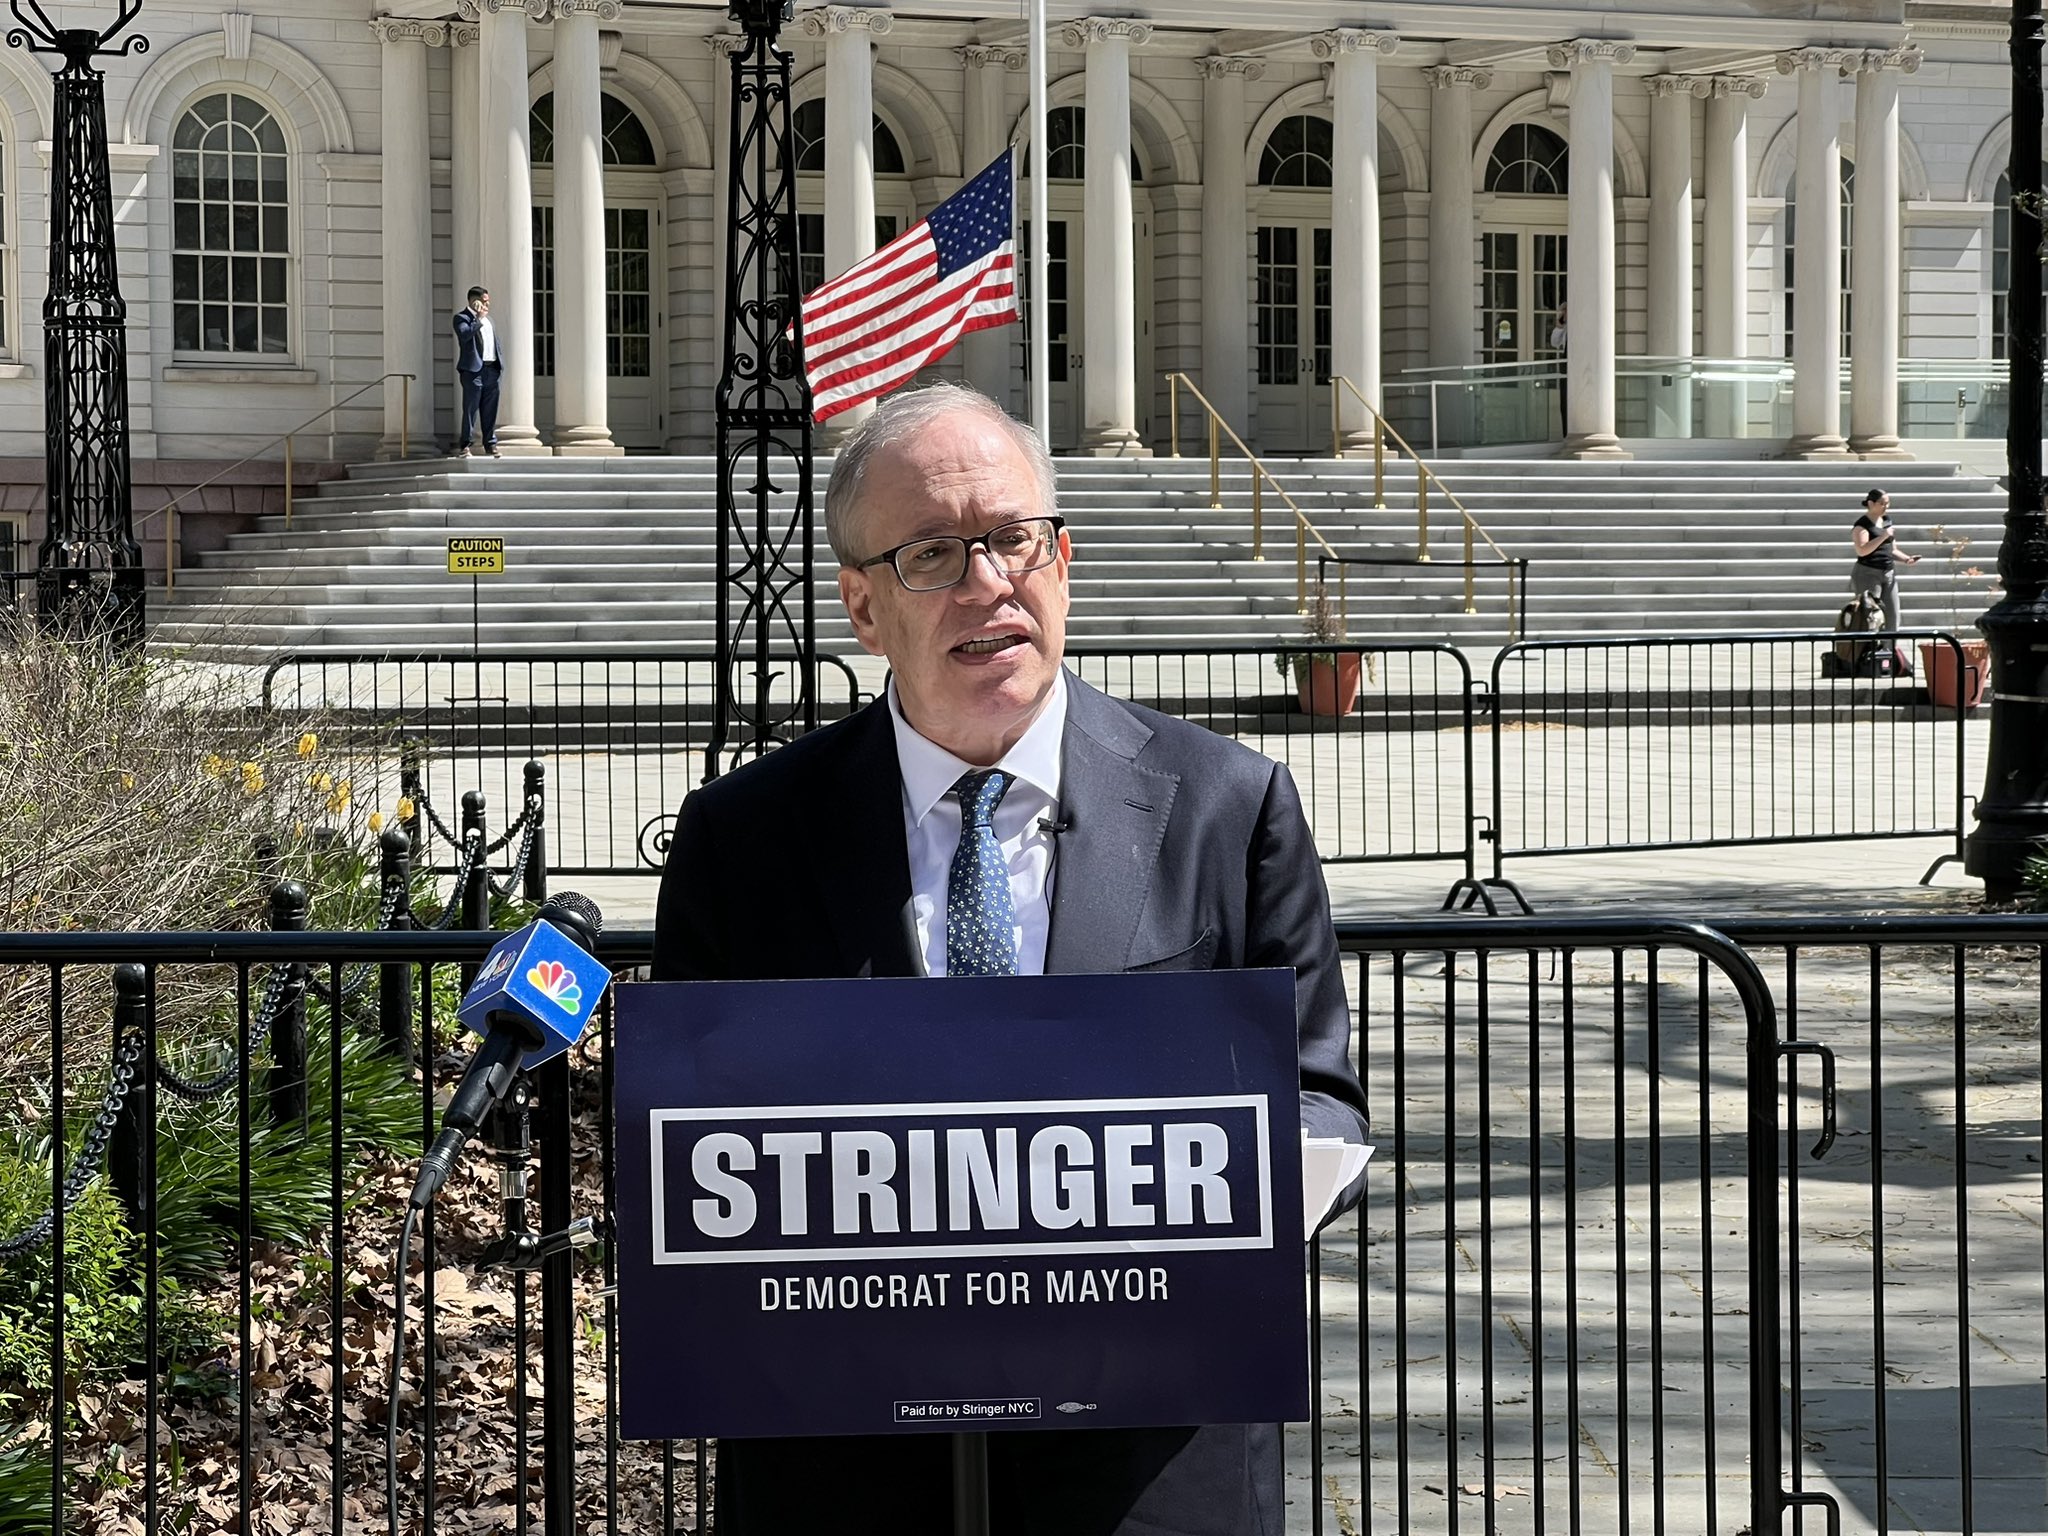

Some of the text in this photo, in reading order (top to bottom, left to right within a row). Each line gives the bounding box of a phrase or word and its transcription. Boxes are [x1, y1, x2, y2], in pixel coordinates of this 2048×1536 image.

[451, 540, 501, 551] CAUTION
[457, 556, 495, 568] STEPS
[476, 949, 505, 982] 4
[691, 1123, 1234, 1238] STRINGER
[760, 1267, 1168, 1311] DEMOCRAT FOR MAYOR
[901, 1402, 1034, 1417] Paid for by Stringer NYC
